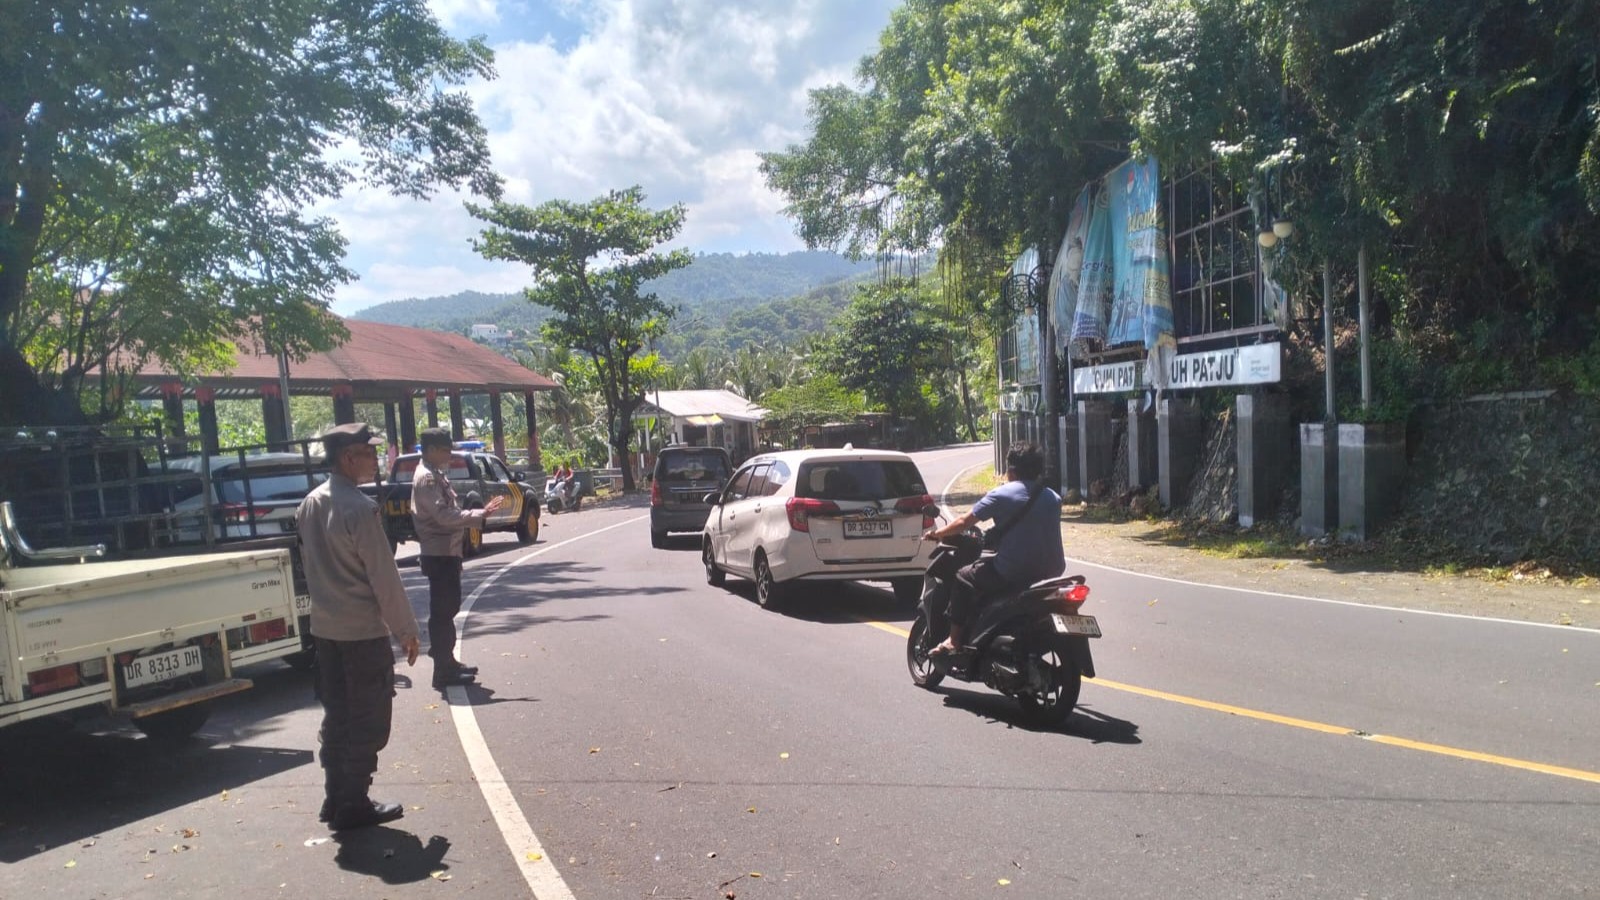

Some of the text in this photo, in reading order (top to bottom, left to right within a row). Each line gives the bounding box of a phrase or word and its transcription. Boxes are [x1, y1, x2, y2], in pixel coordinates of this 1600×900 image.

[127, 649, 200, 680] DR 8313 DH
